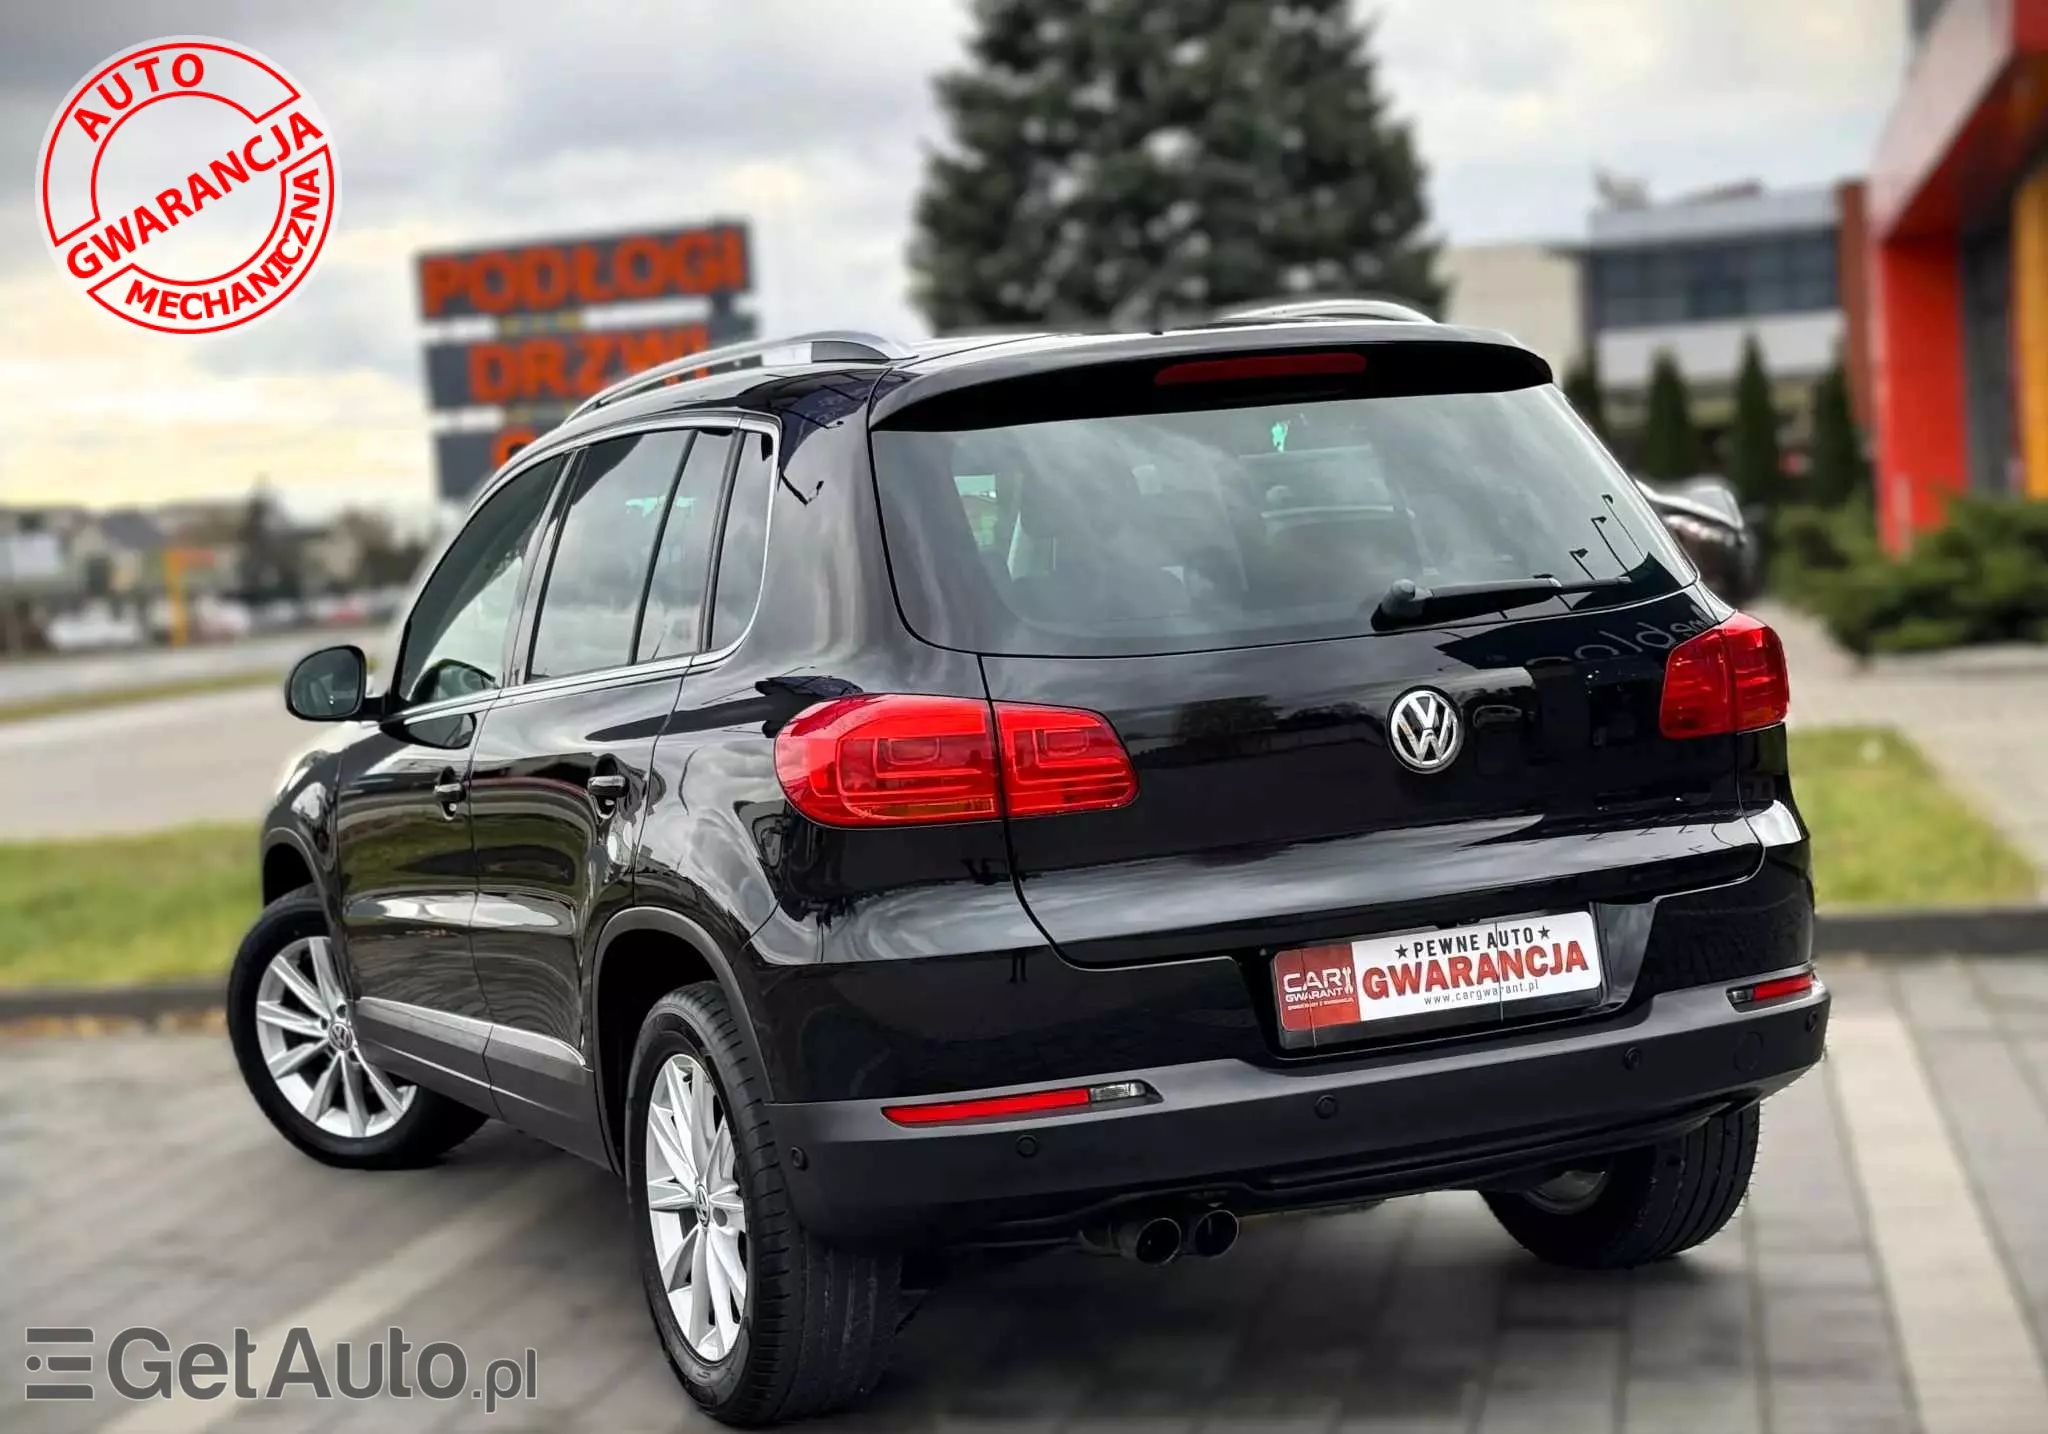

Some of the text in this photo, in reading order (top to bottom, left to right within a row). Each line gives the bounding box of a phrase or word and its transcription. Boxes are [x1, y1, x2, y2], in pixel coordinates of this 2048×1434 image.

[1413, 927, 1534, 958] PEWNE AUTO
[1283, 967, 1343, 993] CAR
[1362, 940, 1589, 1001] GWARANCJA
[1285, 987, 1343, 1003] GWARANT
[1423, 980, 1539, 1007] www.cargwarant.pl
